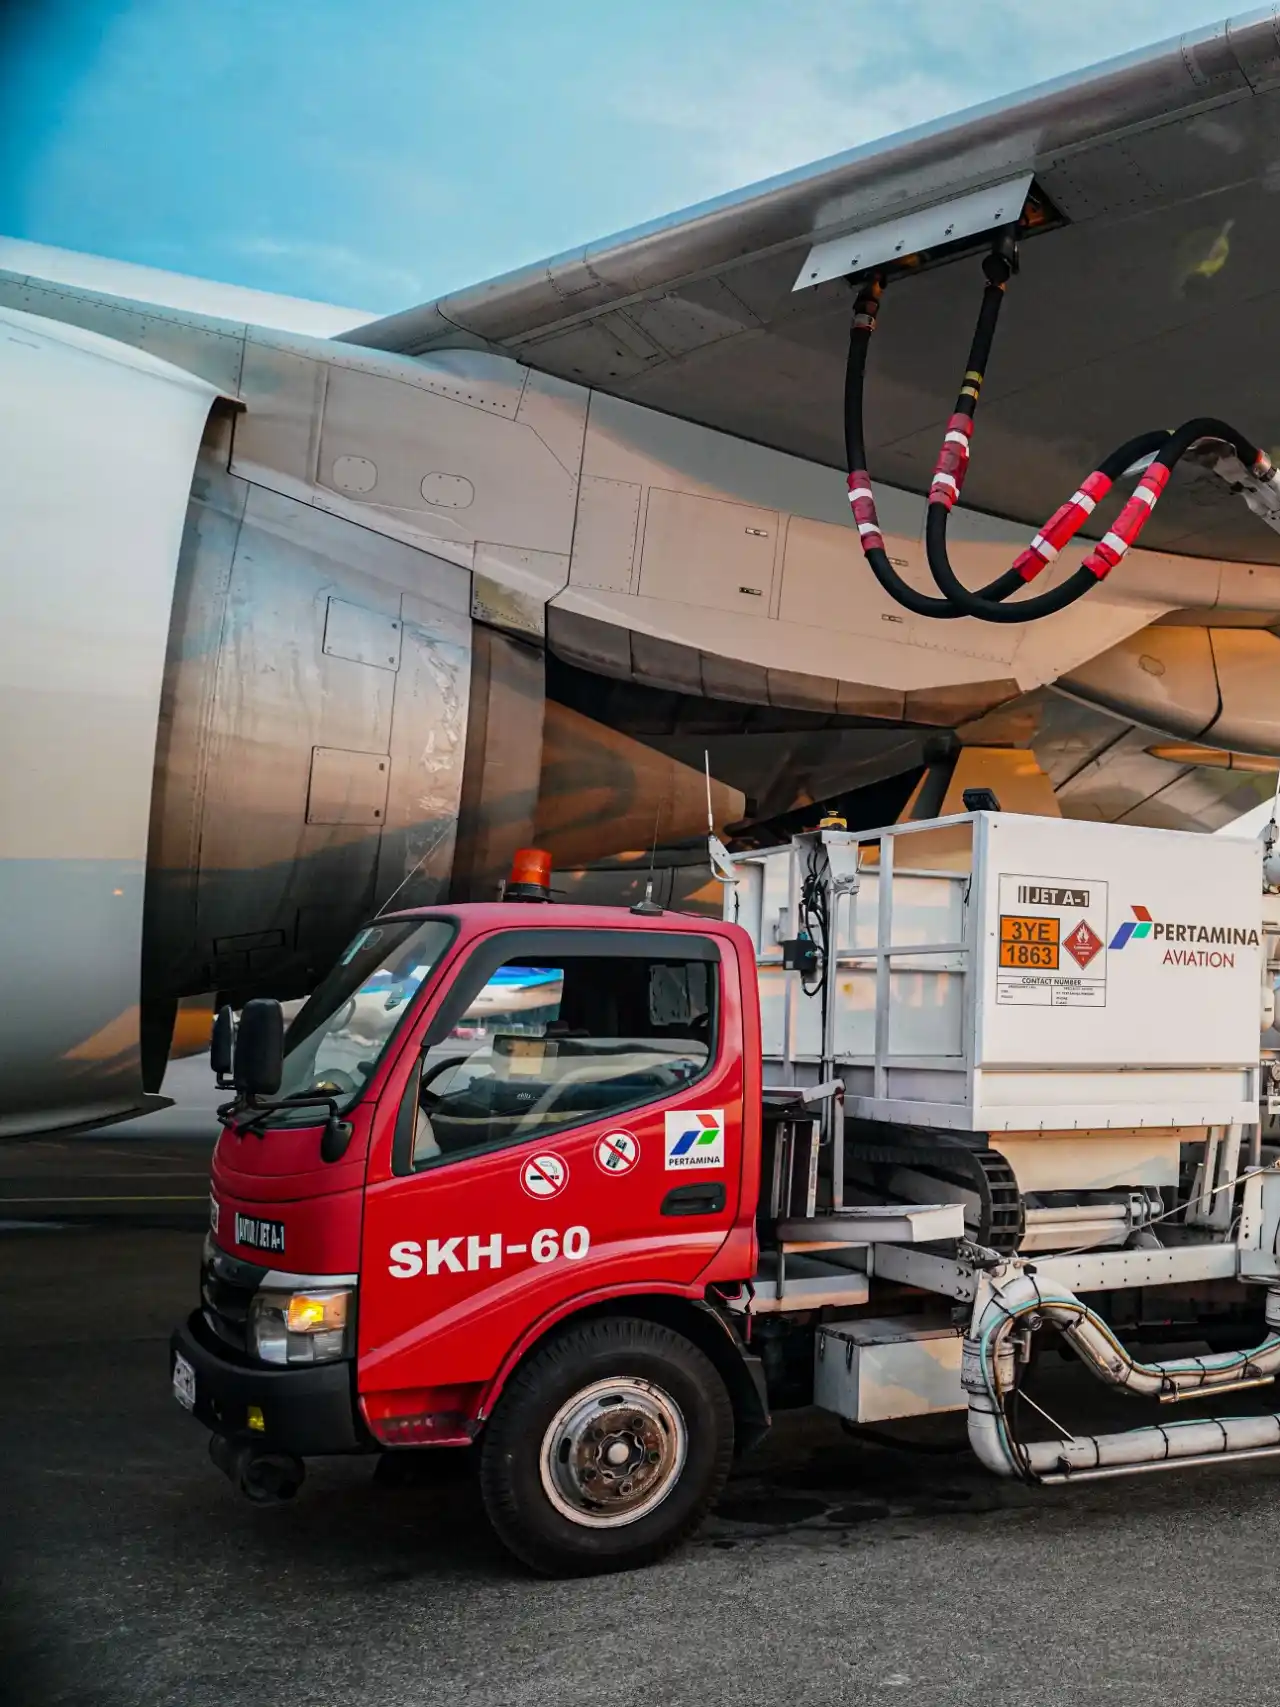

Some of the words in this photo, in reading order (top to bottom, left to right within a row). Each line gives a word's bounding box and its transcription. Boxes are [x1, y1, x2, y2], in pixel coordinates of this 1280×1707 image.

[1031, 888, 1059, 904] JET
[1062, 890, 1089, 907] A-1
[1011, 921, 1050, 942] 3YE
[1153, 922, 1260, 947] PERTAMINA
[1006, 945, 1052, 965] 1863
[1162, 949, 1235, 968] AVIATION
[1021, 977, 1052, 985] CONTACT
[669, 1156, 721, 1166] PERTAMINA
[388, 1225, 591, 1279] SKH-60
